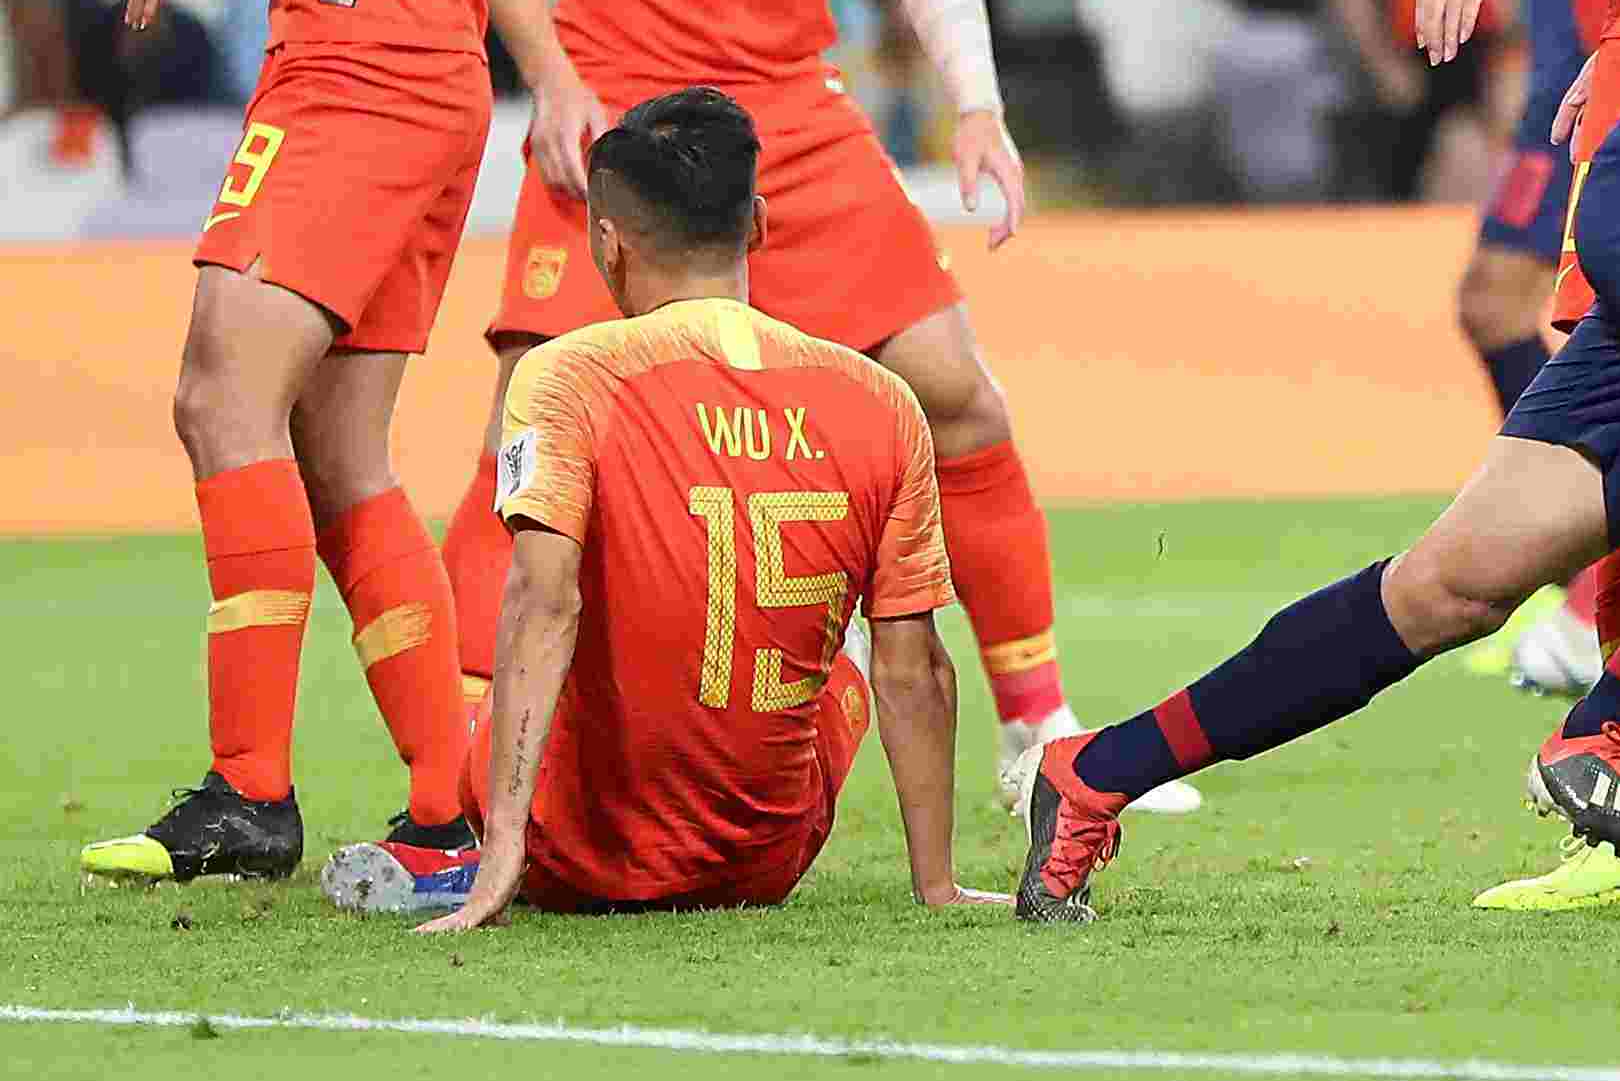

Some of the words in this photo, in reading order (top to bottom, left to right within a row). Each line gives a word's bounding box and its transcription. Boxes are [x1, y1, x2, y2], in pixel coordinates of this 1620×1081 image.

[218, 121, 287, 209] 9
[696, 402, 773, 462] WU
[785, 407, 826, 461] X.
[688, 486, 850, 713] 15
